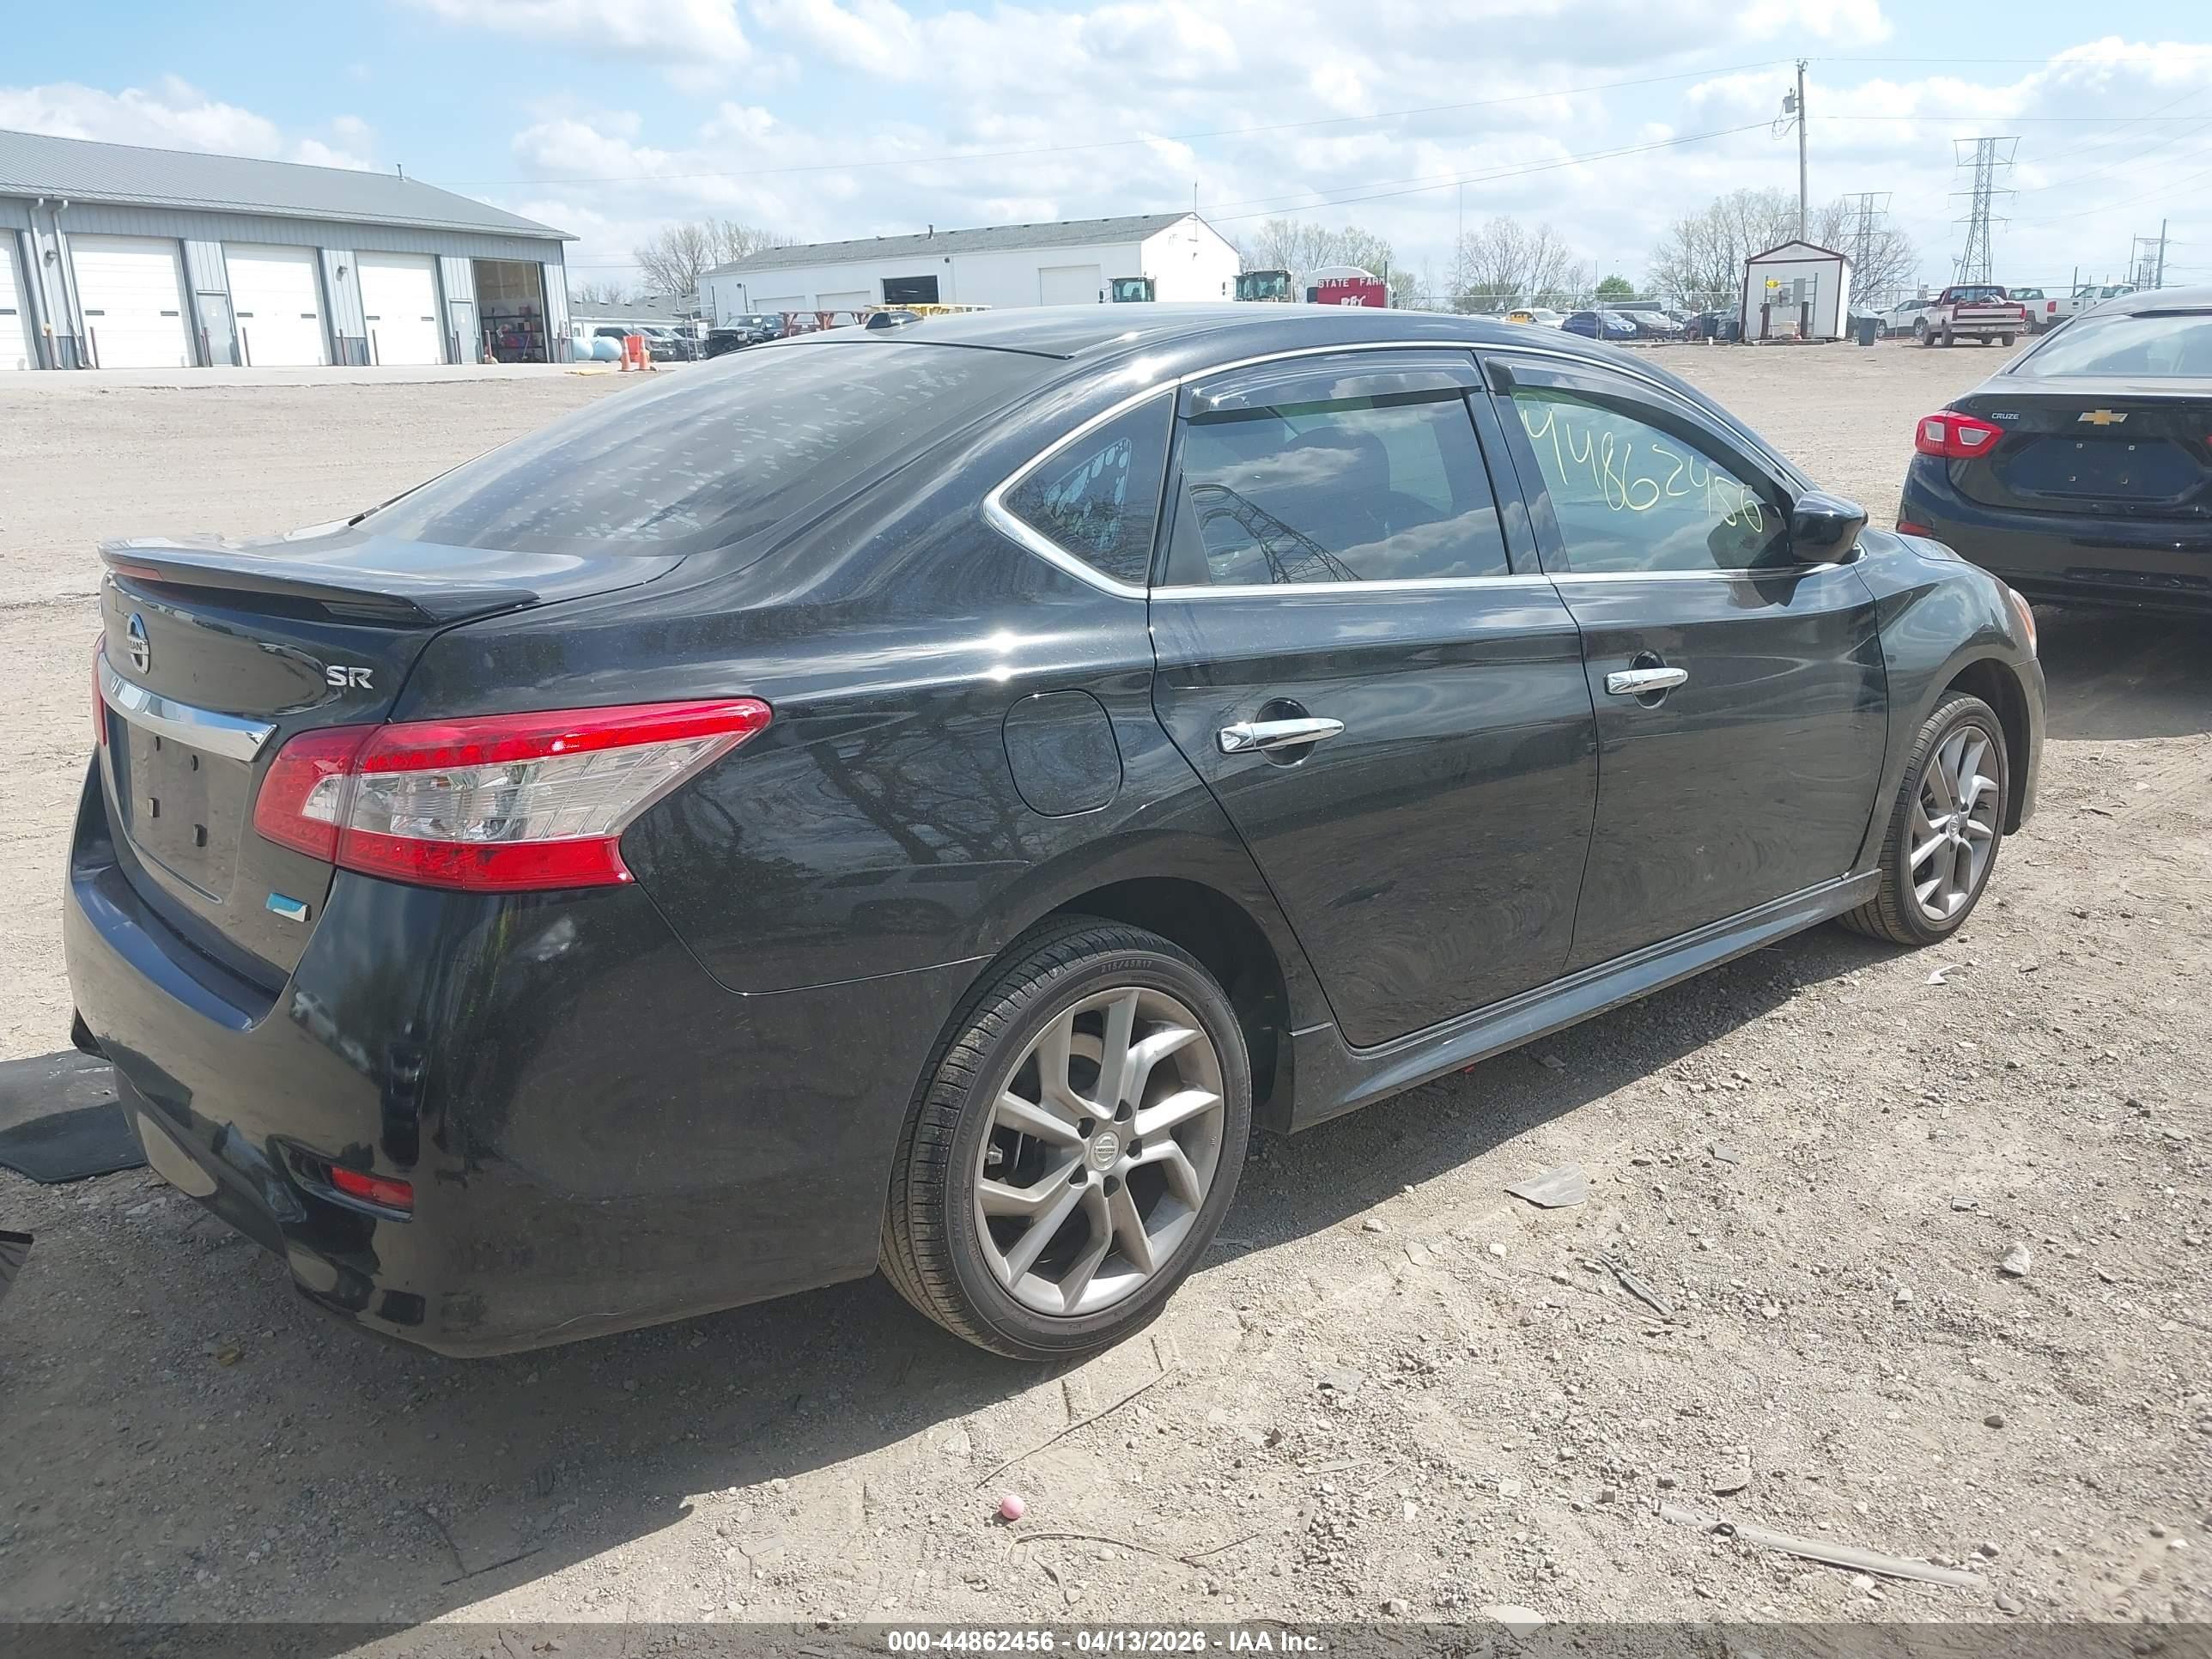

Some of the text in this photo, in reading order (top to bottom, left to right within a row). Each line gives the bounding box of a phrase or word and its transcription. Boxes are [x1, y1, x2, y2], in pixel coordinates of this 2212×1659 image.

[1318, 276, 1385, 289] STATE FARM
[326, 665, 374, 690] SR
